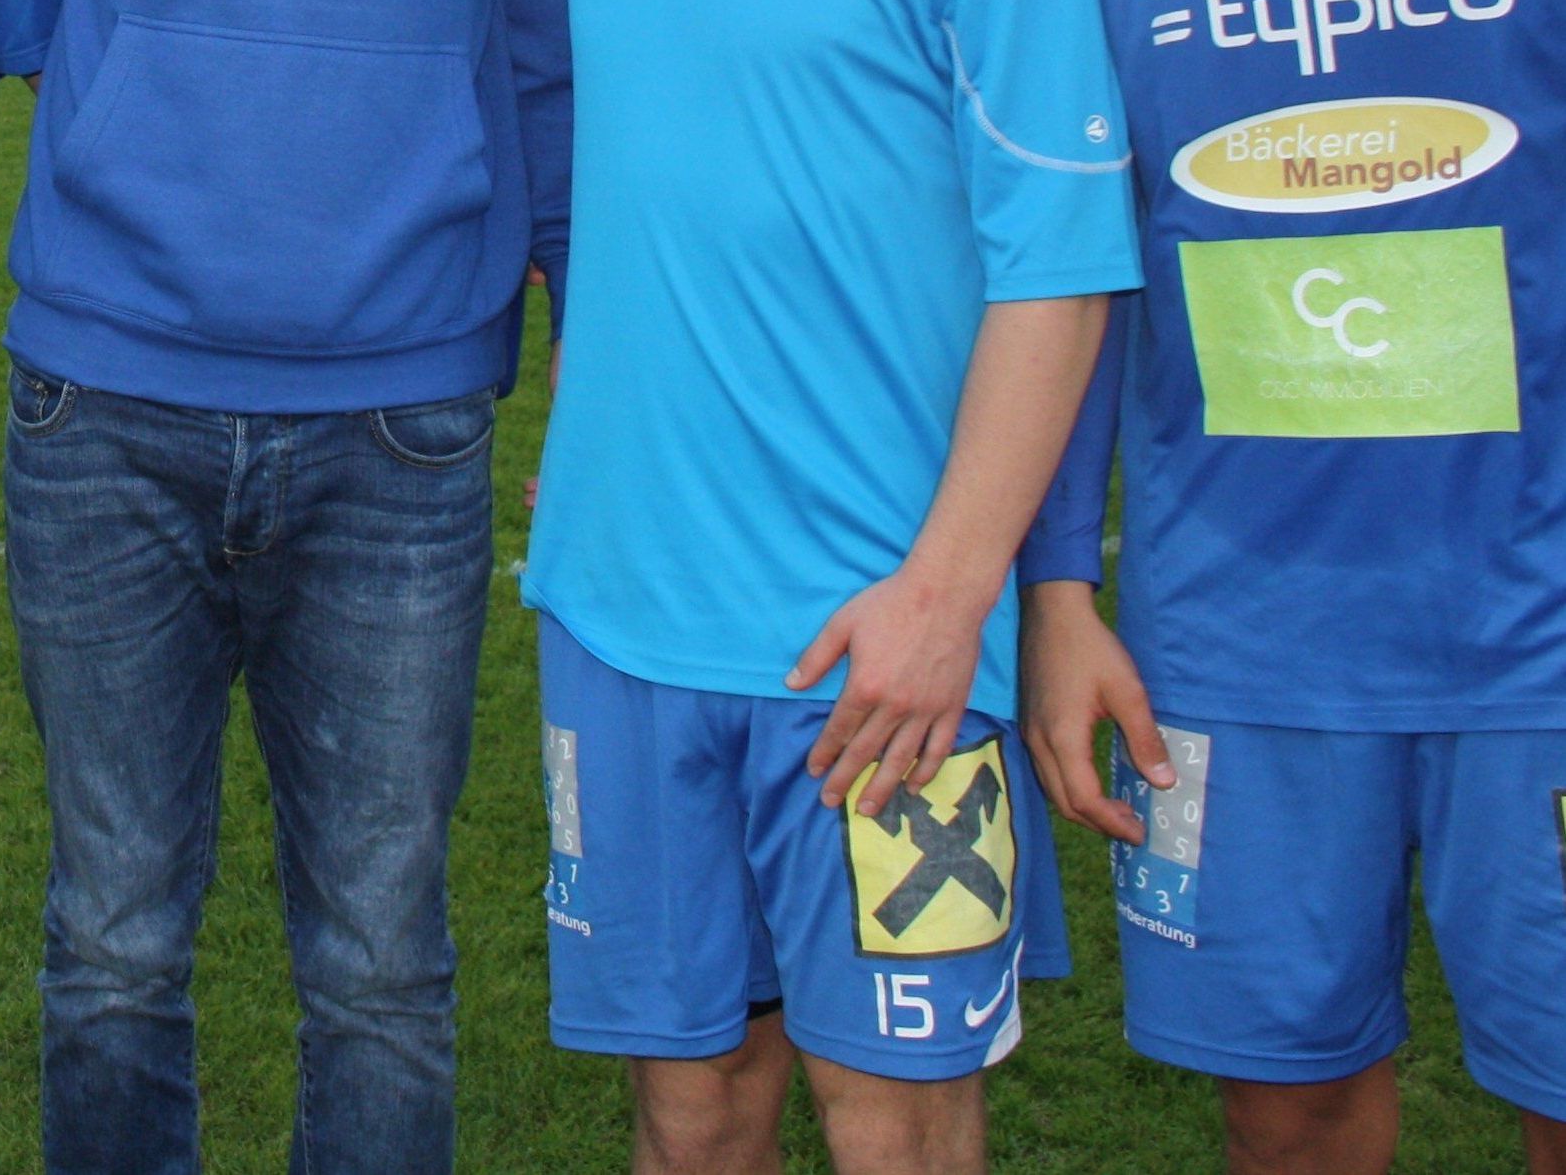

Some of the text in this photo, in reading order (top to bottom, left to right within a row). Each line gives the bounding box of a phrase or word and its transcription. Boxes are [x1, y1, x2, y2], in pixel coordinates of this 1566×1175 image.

[1226, 120, 1397, 163] Bäckerei
[1283, 147, 1462, 193] Mangold
[874, 972, 934, 1039] 15
